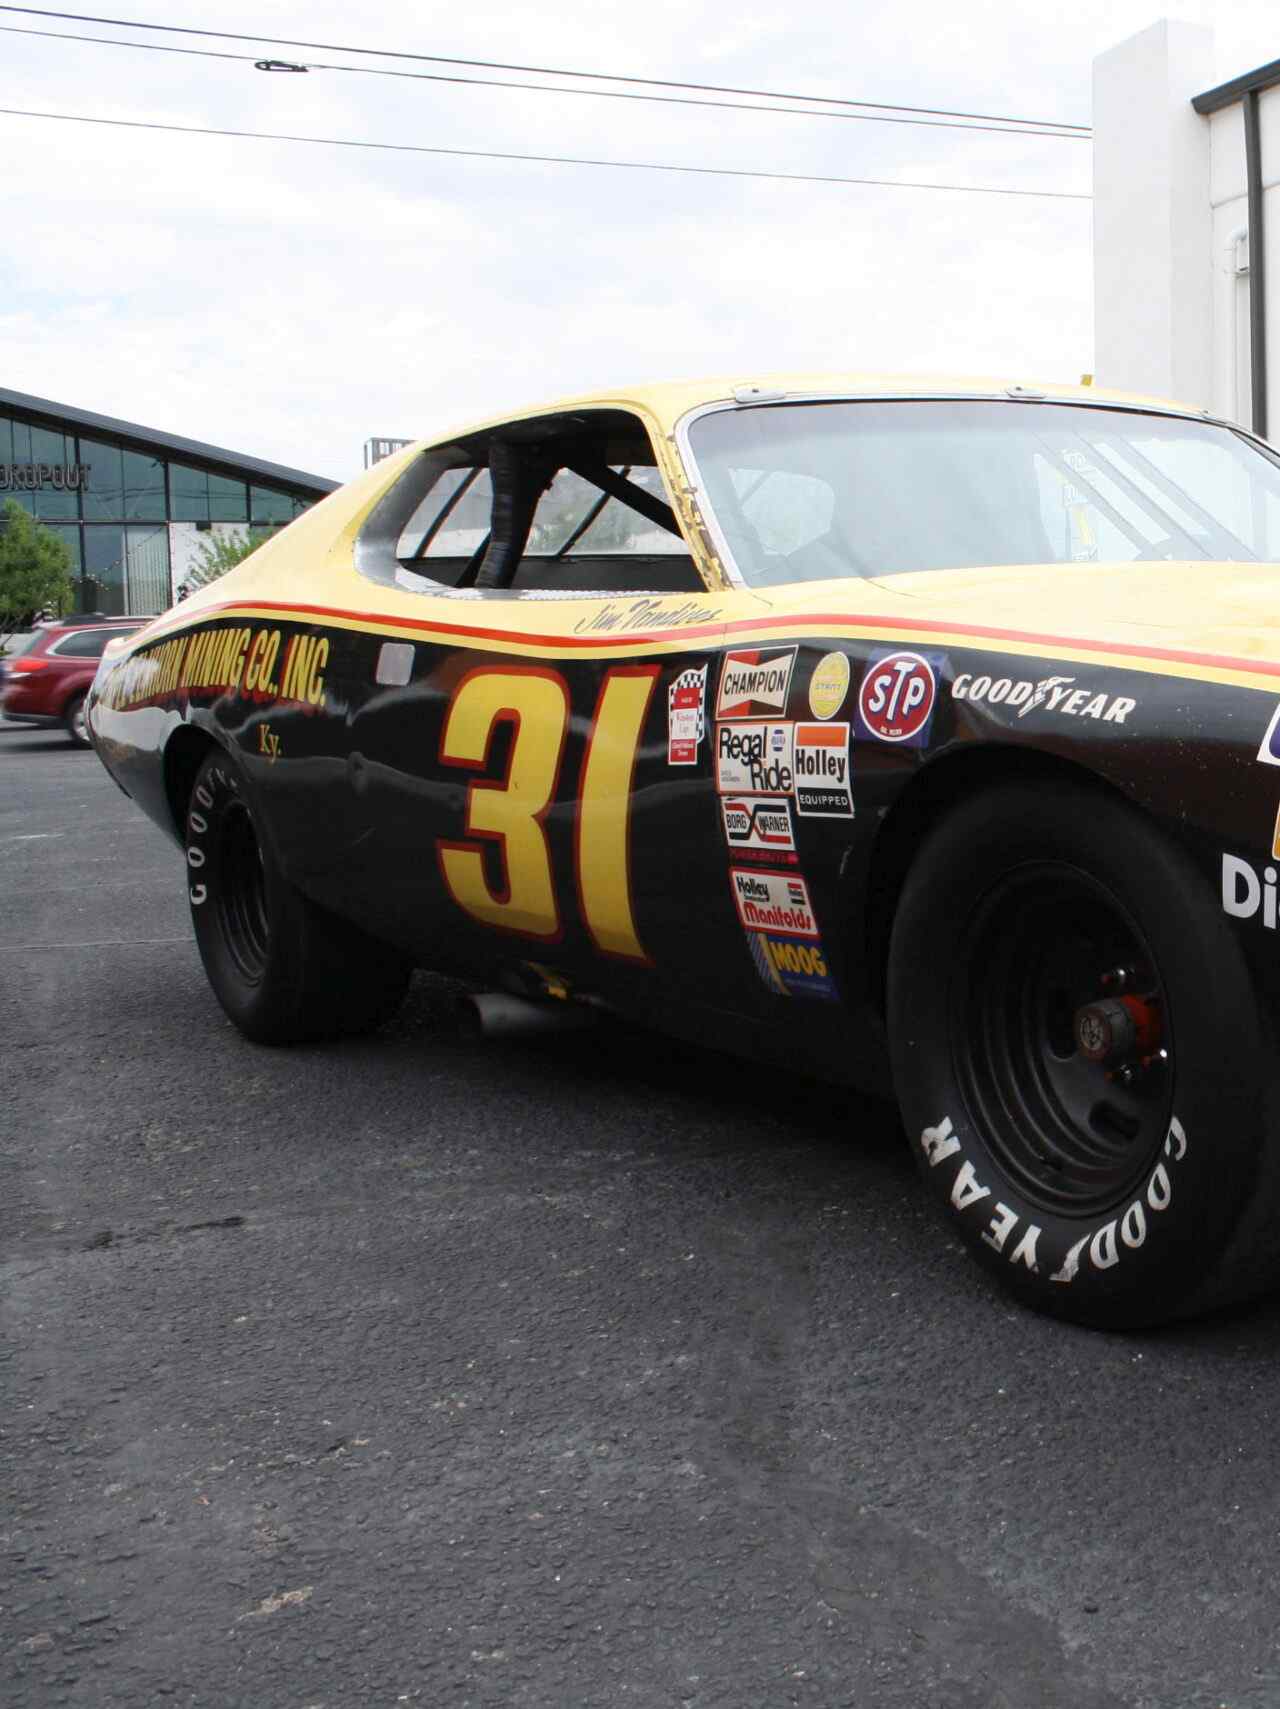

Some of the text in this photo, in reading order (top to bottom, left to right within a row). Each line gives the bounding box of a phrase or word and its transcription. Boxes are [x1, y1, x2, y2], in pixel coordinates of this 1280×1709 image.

[281, 634, 329, 707] INC.
[723, 669, 788, 696] CHAMPION
[868, 661, 925, 720] STP
[952, 674, 1136, 723] GOODYEAR
[258, 724, 282, 763] Ky.
[719, 726, 768, 766] Regal
[751, 758, 792, 792] Ride
[795, 749, 846, 783] Holley
[436, 664, 661, 968] 31
[799, 794, 848, 807] EQUIPPED
[726, 813, 790, 833] BORG WARNER
[736, 876, 769, 901] Holley
[743, 901, 811, 930] Manifolds
[769, 941, 828, 977] MOOG
